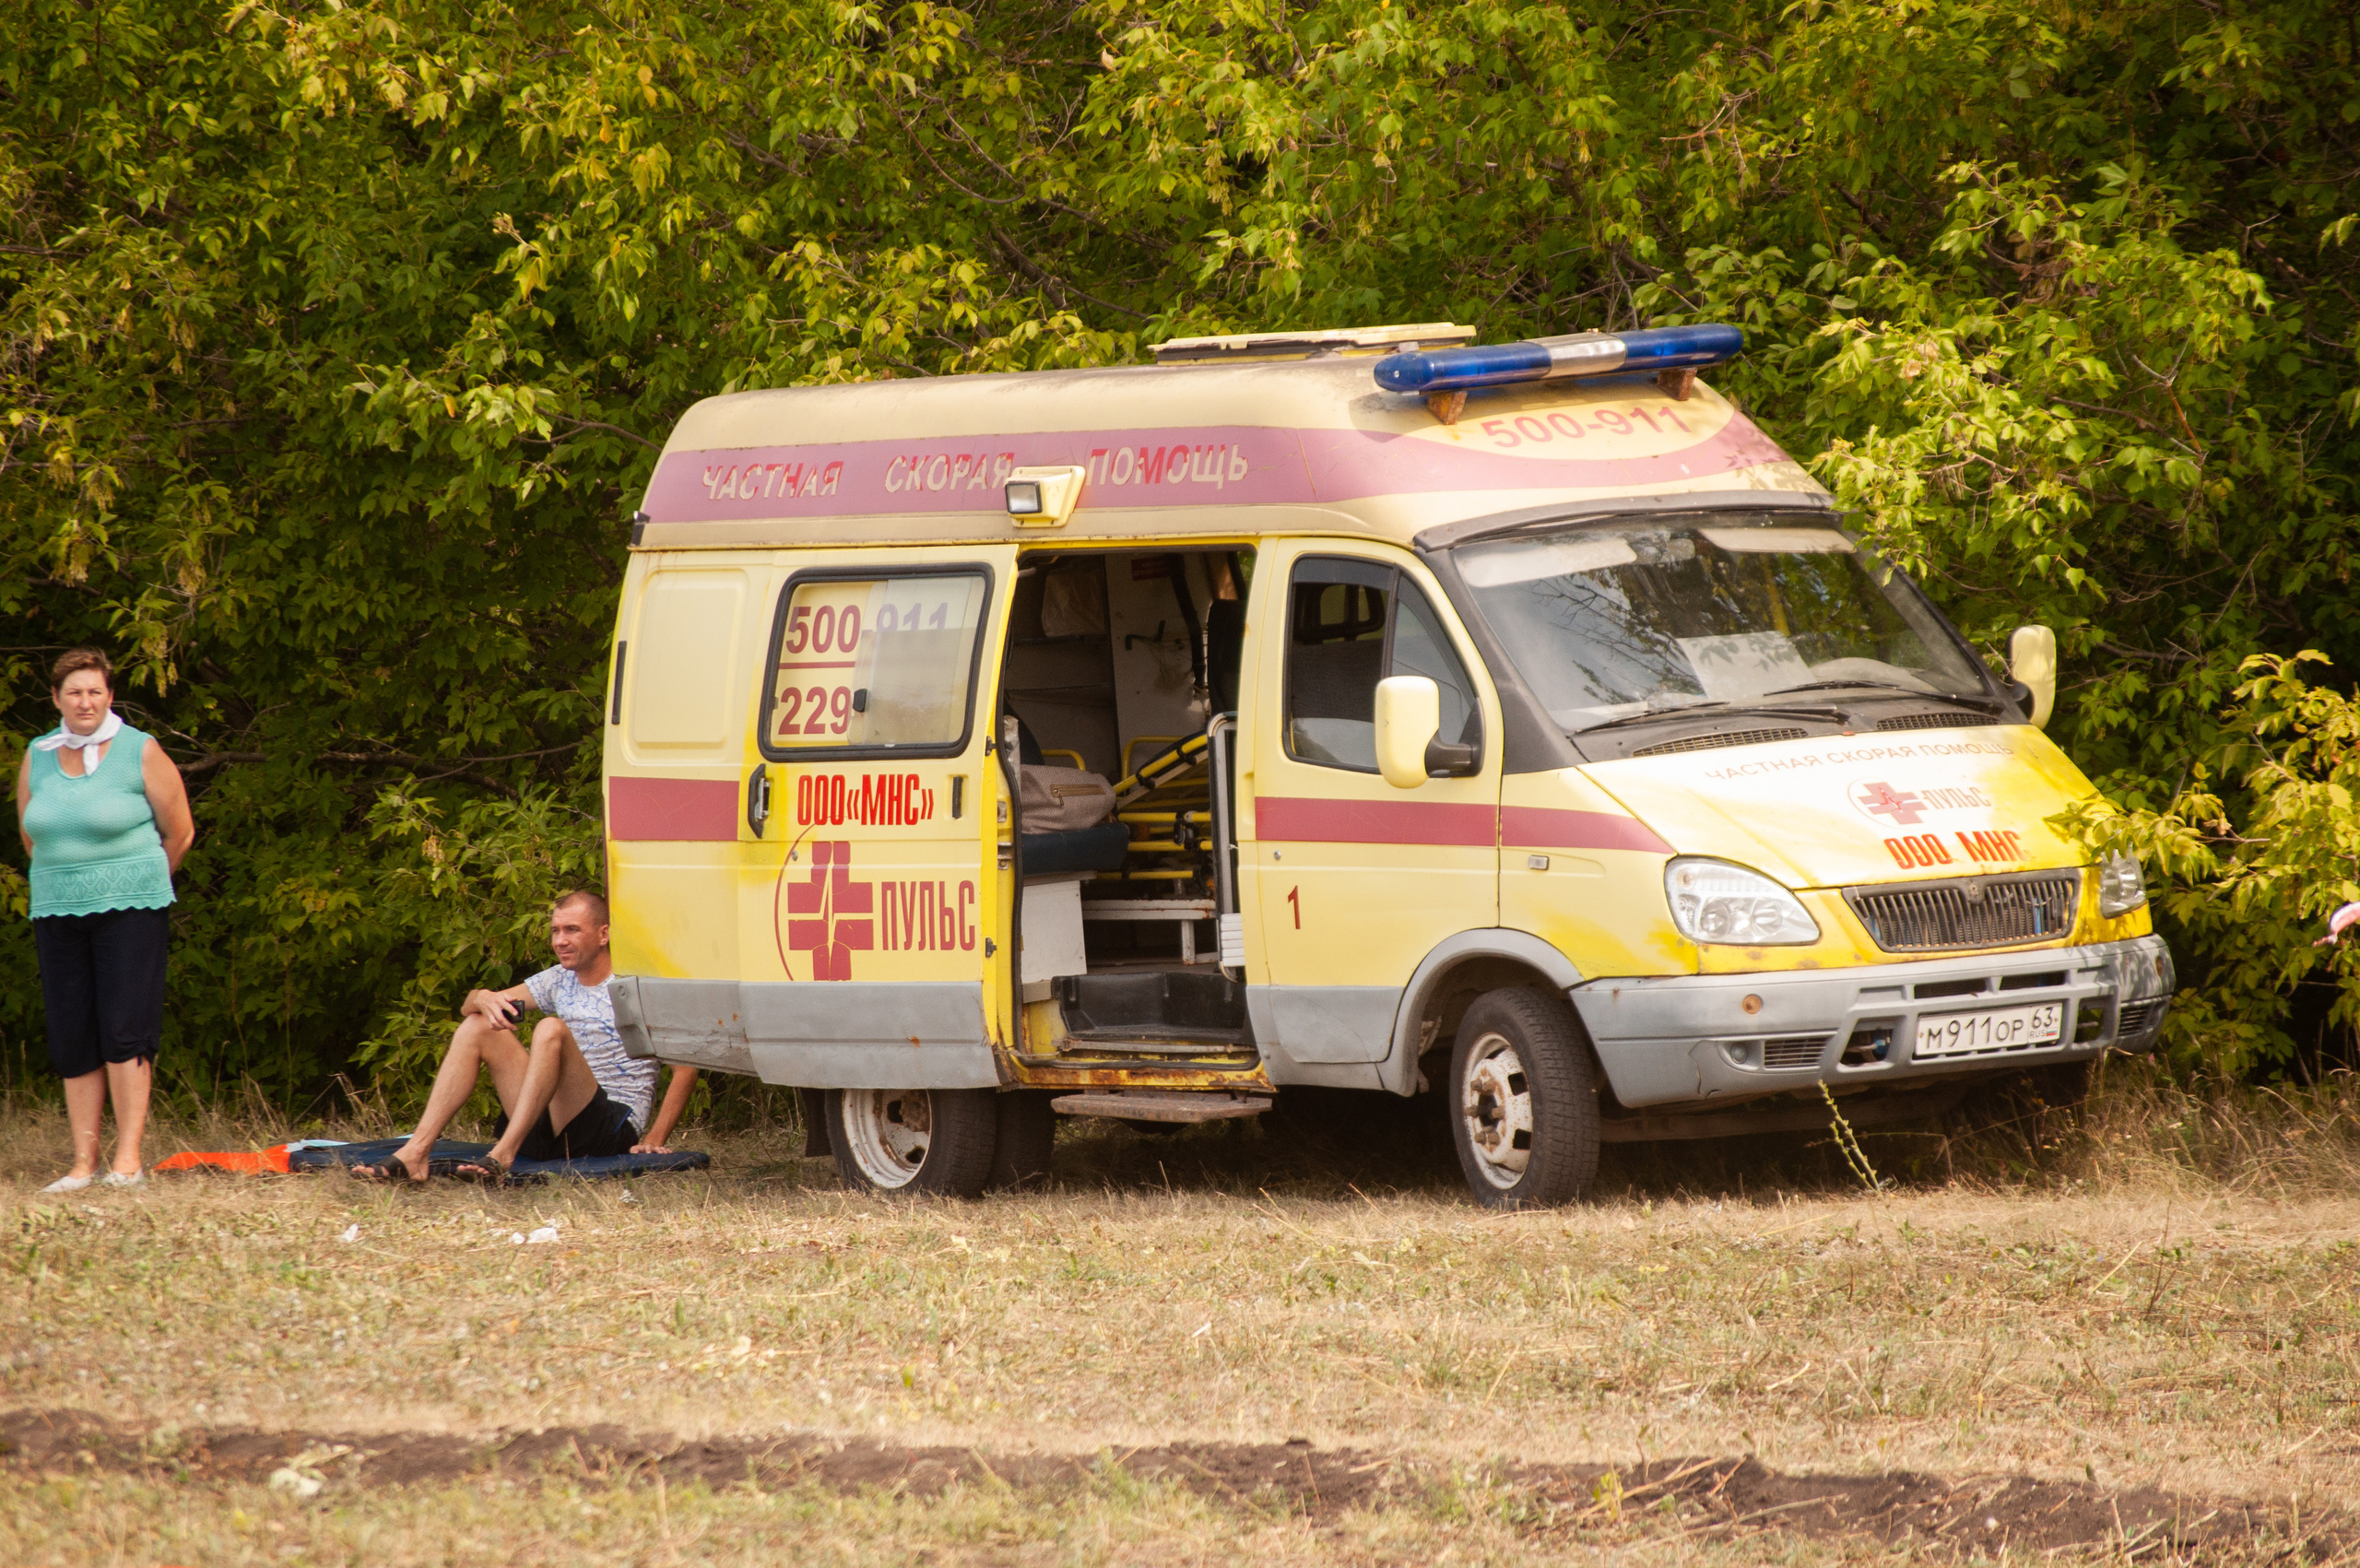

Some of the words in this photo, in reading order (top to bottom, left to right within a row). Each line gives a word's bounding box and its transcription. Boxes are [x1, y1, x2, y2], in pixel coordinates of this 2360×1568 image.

[1481, 406, 1693, 448] 500-911
[702, 460, 844, 501] ЧАСТНАЯ
[884, 452, 1016, 493] СКОРАЯ
[1085, 444, 1249, 489] ПОМОЩЬ
[777, 685, 853, 736] 229
[1705, 754, 1823, 780] ЧАСТНАЯ
[1826, 746, 1918, 764] СКОРАЯ
[1918, 743, 2014, 759] ПОМОЩЬ
[1921, 786, 1992, 810] ПУЛЬС
[1883, 833, 1954, 870] ООО
[1954, 830, 2032, 863] МНС
[880, 879, 976, 951] ПУЛЬС
[1287, 884, 1301, 930] 1
[2029, 1029, 2047, 1039] RUS
[2031, 1006, 2055, 1030] 63
